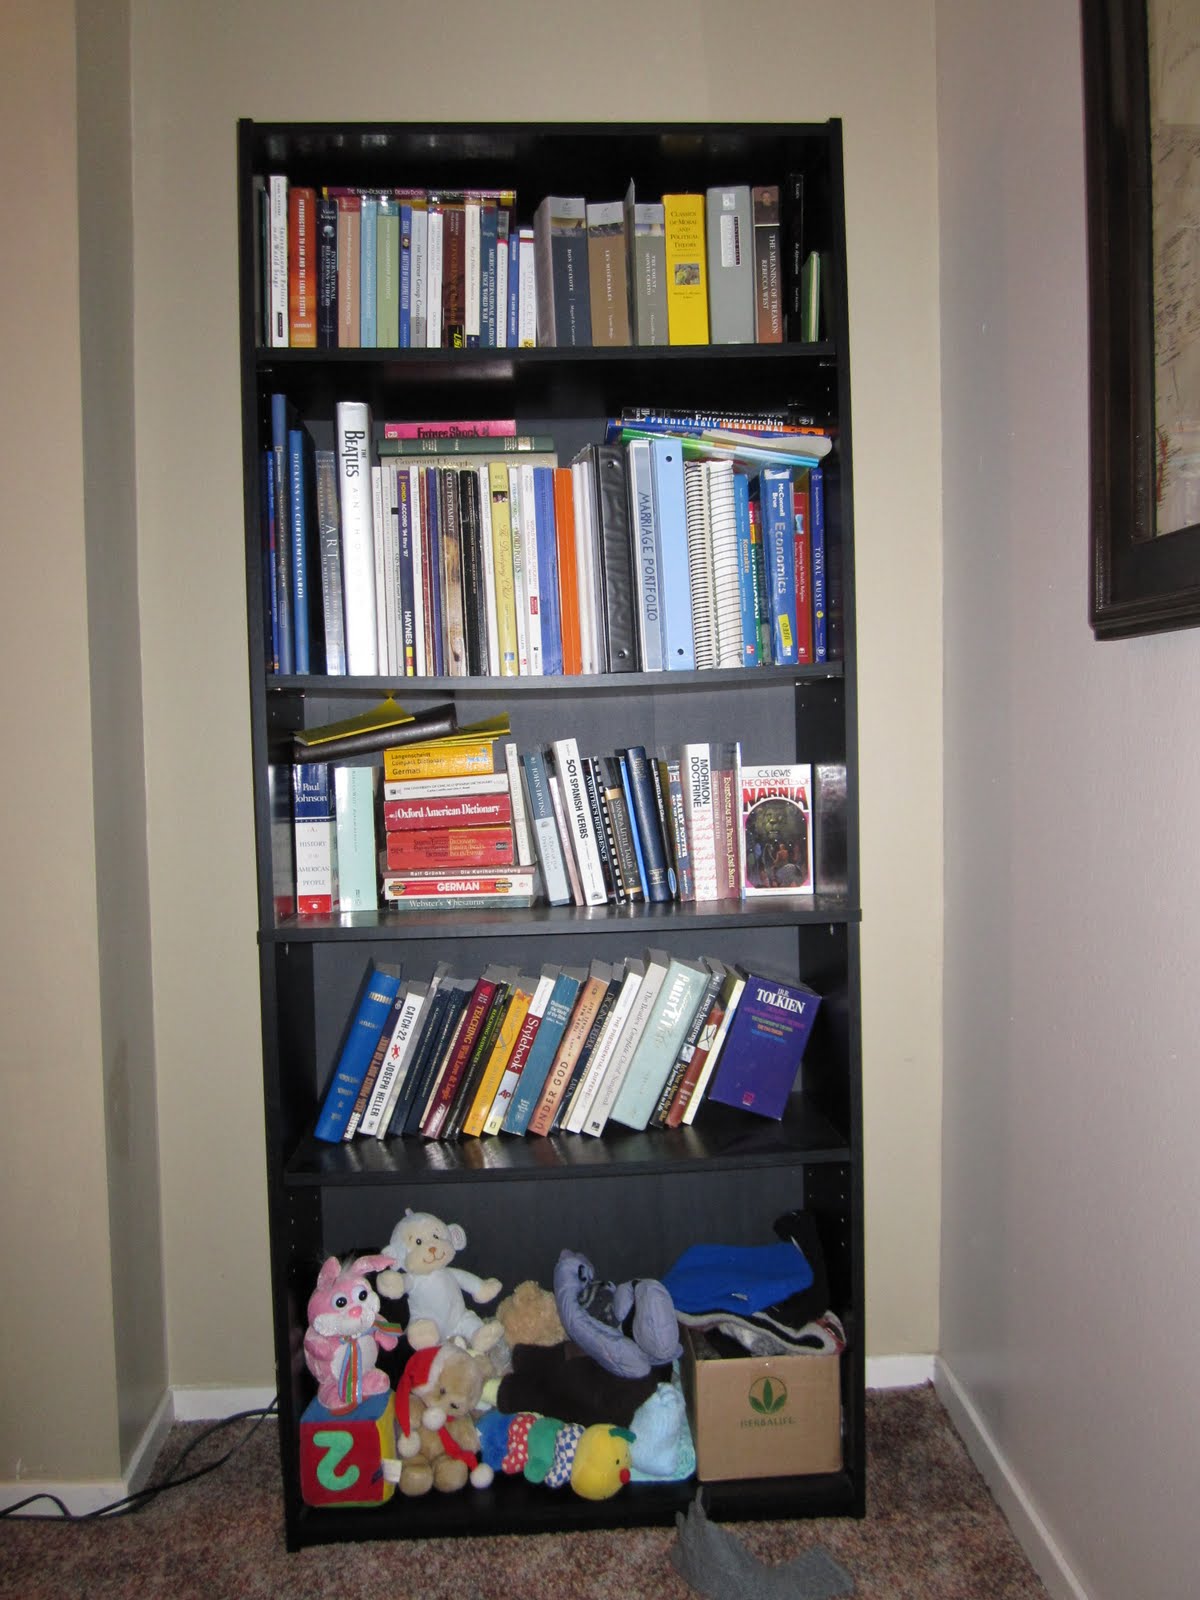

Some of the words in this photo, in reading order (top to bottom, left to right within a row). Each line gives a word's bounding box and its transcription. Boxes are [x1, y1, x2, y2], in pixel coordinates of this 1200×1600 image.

[769, 250, 777, 287] MEANING
[770, 288, 777, 298] OF
[450, 425, 479, 438] Shock
[651, 416, 720, 428] PREDICTABLY
[721, 421, 784, 433] IRRATIONAL
[341, 430, 366, 477] BEATLES
[445, 471, 453, 489] OLD
[447, 491, 455, 532] TESTAMENT
[771, 492, 779, 508] Brue
[778, 483, 786, 517] McConnell
[638, 492, 654, 553] MARRIAGE
[294, 513, 302, 567] CHRISTMAS
[324, 524, 338, 560] ART
[513, 530, 521, 549] WORLD
[514, 550, 522, 573] POLITICS
[743, 538, 751, 573] Kontakte
[774, 522, 789, 594] Economics
[296, 569, 304, 600] CAROL
[643, 558, 658, 622] PORTFOLIO
[404, 611, 413, 645] HAYNES
[392, 767, 421, 775] German
[531, 767, 541, 788] JOHN
[566, 759, 576, 777] 501
[771, 769, 792, 778] LEWIS
[302, 782, 320, 791] Paul
[691, 757, 701, 808] DOCTRINE
[700, 759, 710, 804] MORMON
[742, 779, 755, 787] THE
[755, 778, 799, 787] CHRONICLES
[800, 777, 811, 785] OF
[296, 794, 328, 803] Johnson
[535, 789, 546, 817] IRVING
[569, 778, 583, 812] SPANISH
[724, 777, 732, 815] ENSEÑANZAS
[742, 786, 809, 812] NARNIA
[397, 806, 424, 819] Oxford
[425, 805, 461, 818] American
[462, 803, 500, 816] Dictionary
[587, 779, 599, 815] WRITER'S
[593, 816, 608, 862] REFERENCE
[675, 793, 686, 825] HARRY
[577, 813, 588, 839] VERBS
[680, 826, 688, 858] POTTER
[726, 827, 734, 854] PROFETA
[437, 882, 480, 891] GERMAN
[728, 868, 736, 888] SMITH
[409, 899, 443, 907] Webster's
[447, 898, 485, 907] Thesaurus
[643, 990, 653, 1003] The
[666, 972, 690, 1010] PARLEY
[701, 992, 716, 1012] Lance
[756, 988, 805, 1014] TOLKIEN
[396, 1005, 415, 1041] CATCH-22
[462, 1004, 484, 1044] TEACHING
[482, 1008, 498, 1036] REACHING
[612, 1015, 621, 1029] THE
[634, 1003, 647, 1026] Beatles
[687, 1010, 709, 1045] Armstrong
[457, 1042, 469, 1059] With
[472, 1035, 487, 1064] AUDIENCES
[507, 1015, 539, 1071] Stylebook
[595, 1029, 615, 1071] PRESIDENTIAL
[621, 1026, 638, 1054] Complete
[379, 1061, 396, 1090] JOSEPH
[451, 1059, 462, 1075] Love
[440, 1080, 454, 1101] Logic
[497, 1088, 512, 1100] AP
[535, 1090, 557, 1130] UNDER
[553, 1060, 569, 1086] GOD
[667, 1083, 679, 1101] About
[370, 1091, 386, 1117] HELLER
[740, 1415, 796, 1428] HERBALIFE
